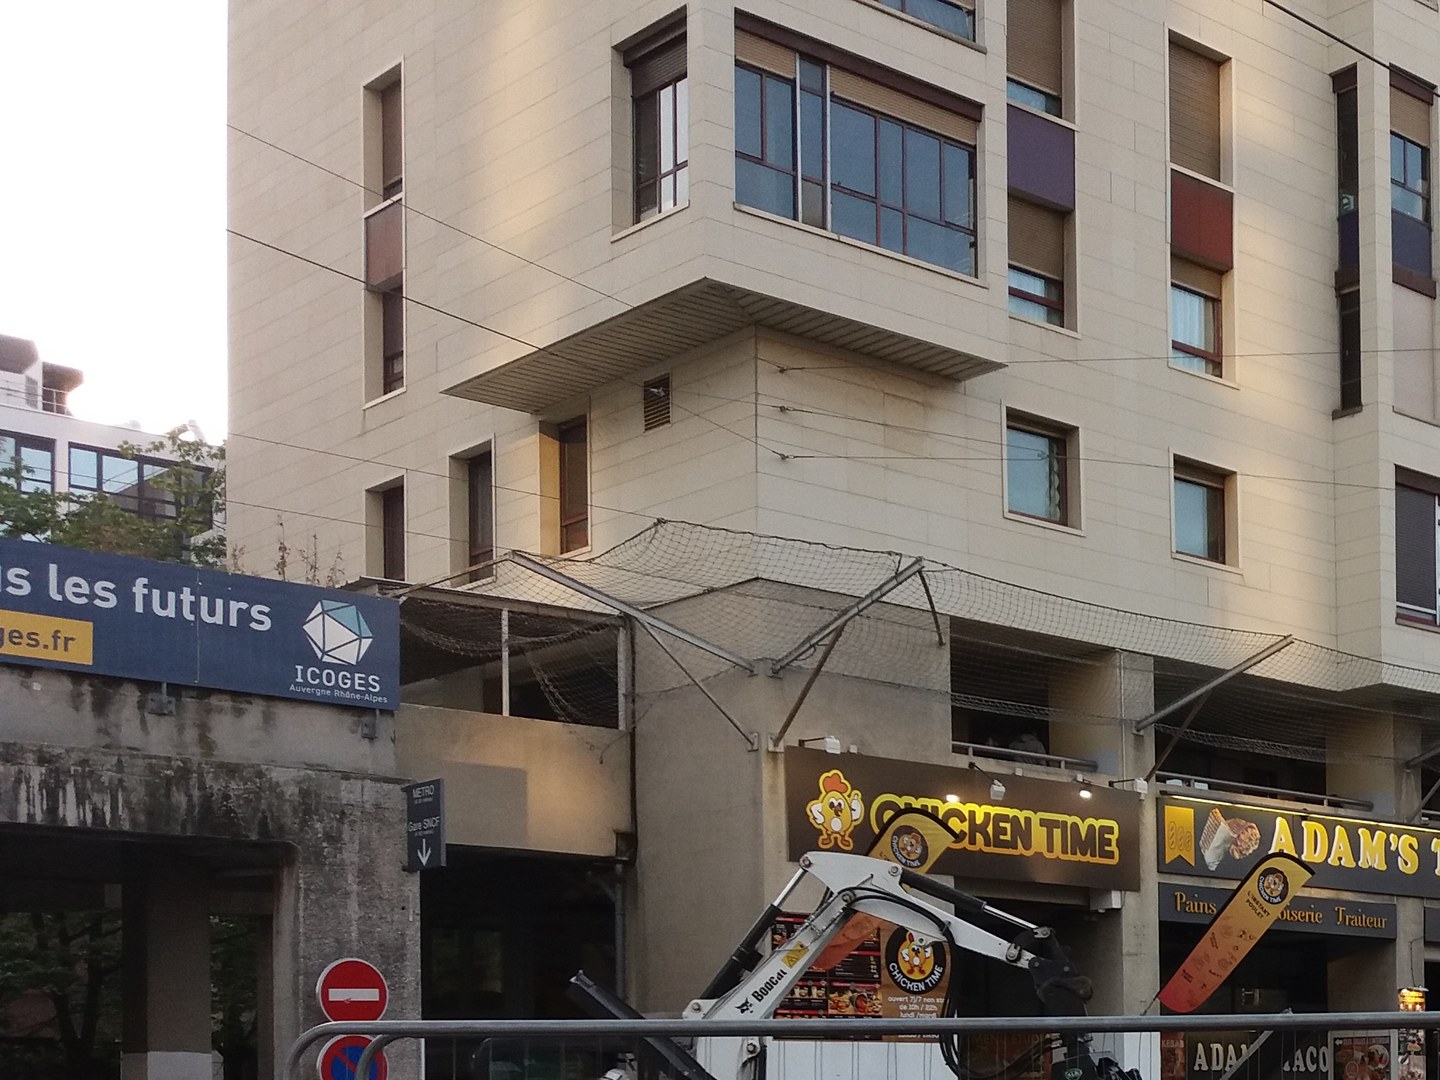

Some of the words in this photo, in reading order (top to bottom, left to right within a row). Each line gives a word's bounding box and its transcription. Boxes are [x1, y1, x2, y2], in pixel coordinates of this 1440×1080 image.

[49, 563, 117, 609] les
[132, 576, 272, 632] futurs
[289, 683, 331, 697] Auvergne
[295, 664, 380, 692] ICOGES
[1038, 815, 1117, 862] TIME
[1268, 816, 1420, 875] ADAM'S
[1174, 891, 1217, 914] Pains
[1278, 904, 1323, 924] oiserie
[1334, 906, 1388, 929] Traiteur
[889, 962, 925, 992] CHICKEN
[924, 964, 943, 987] TIME
